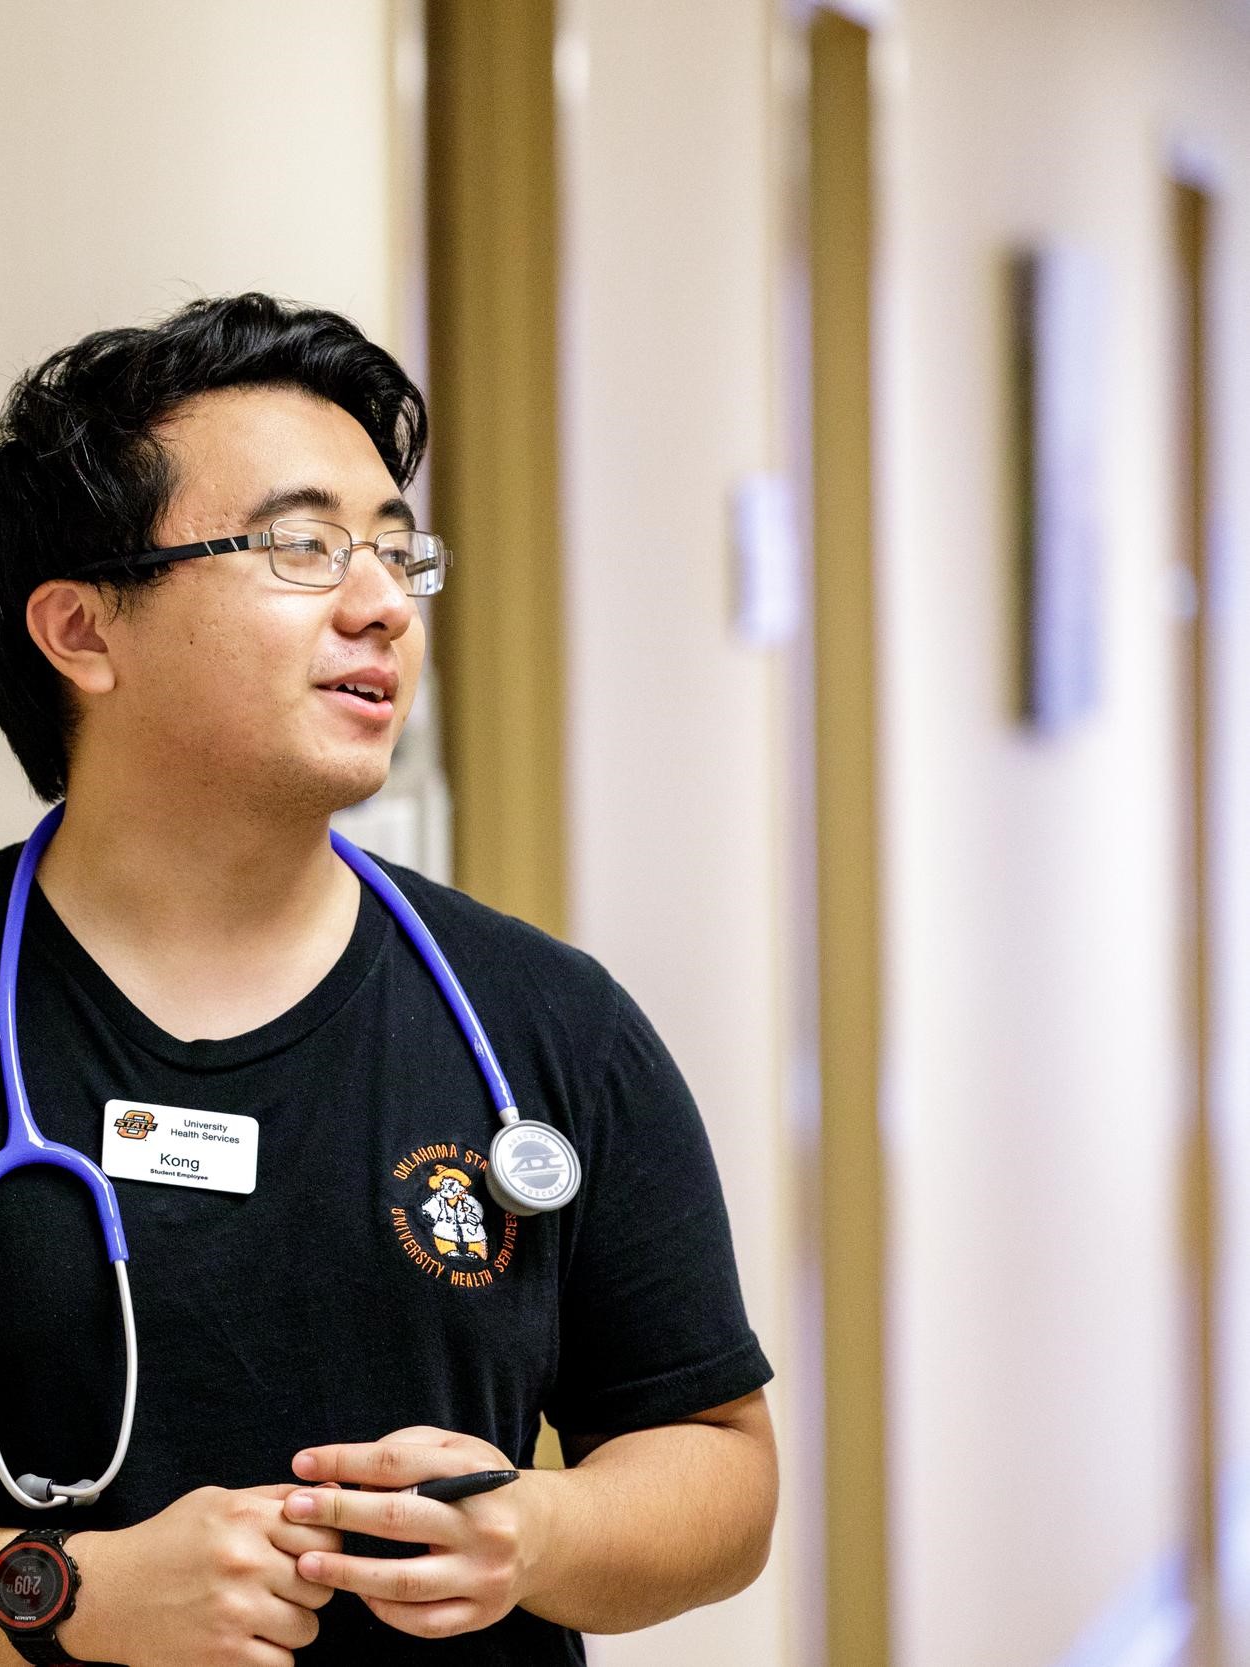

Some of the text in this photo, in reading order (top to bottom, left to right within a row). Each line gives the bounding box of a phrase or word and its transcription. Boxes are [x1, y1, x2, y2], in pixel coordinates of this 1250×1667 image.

[114, 1118, 158, 1132] STATE
[183, 1119, 228, 1133] University
[170, 1128, 240, 1144] Health Services
[160, 1153, 200, 1172] Kong
[393, 1143, 489, 1181] OKLAHOMA STA
[150, 1168, 209, 1181] Student Employee
[391, 1207, 517, 1288] UNIVERSITY HEALTH SERVICES
[14, 1575, 42, 1596] 2:09
